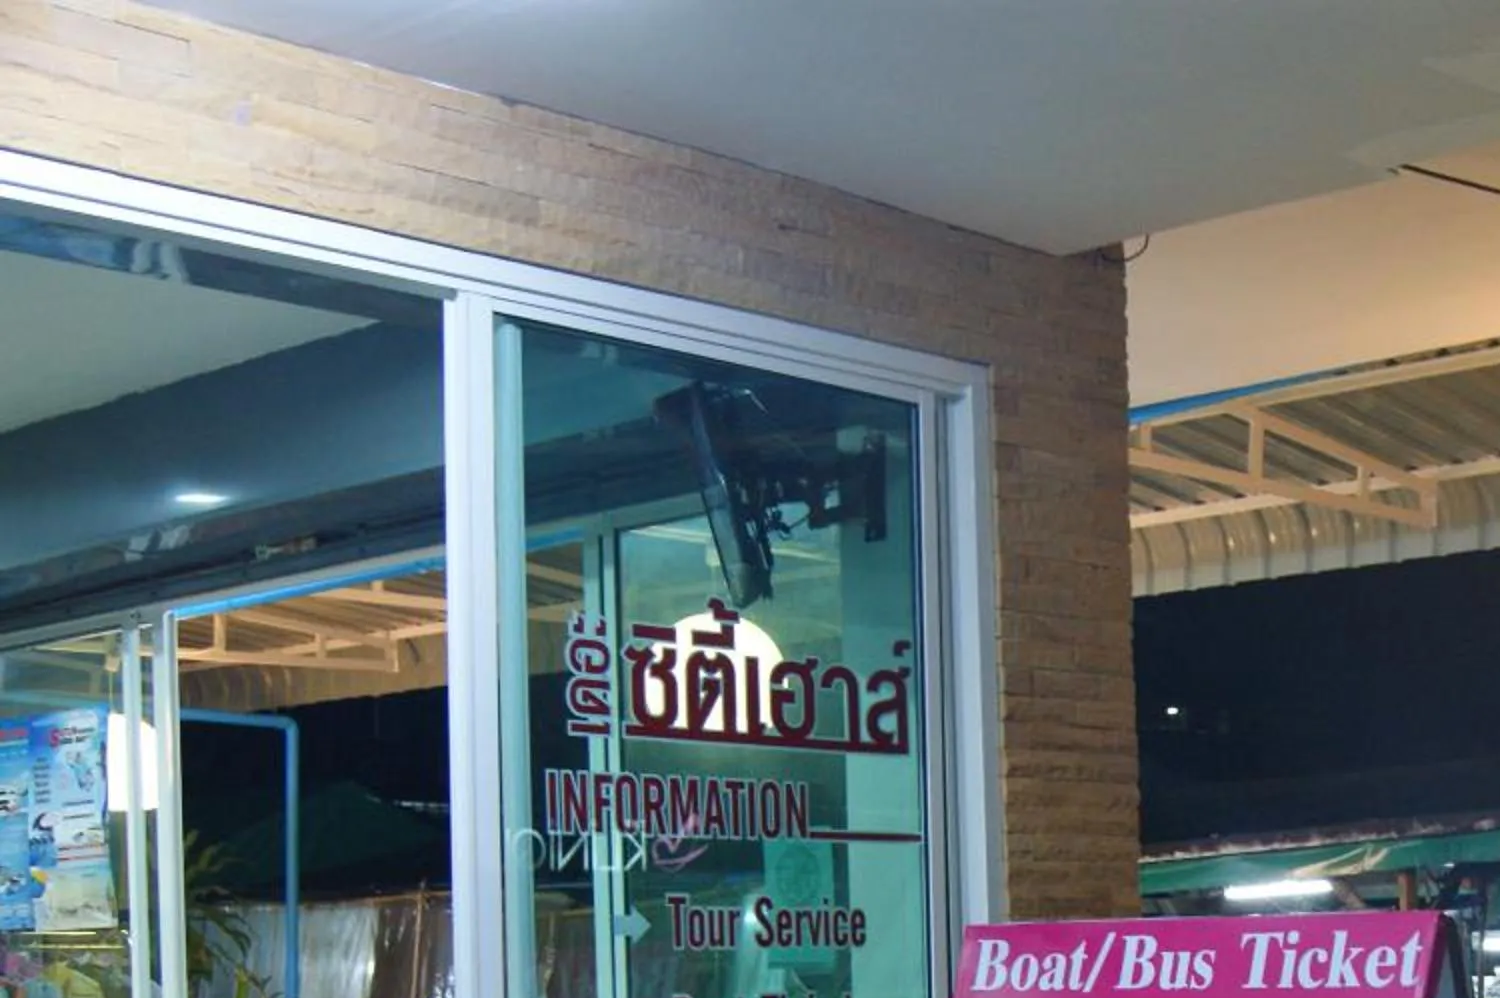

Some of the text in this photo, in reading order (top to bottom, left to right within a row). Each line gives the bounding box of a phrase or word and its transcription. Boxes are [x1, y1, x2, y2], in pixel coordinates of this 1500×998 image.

[566, 608, 611, 736] เดอะ
[545, 769, 809, 839] INFORMATION
[665, 893, 866, 950] Tour Service
[970, 929, 1423, 993] Boat/Bus Ticket
